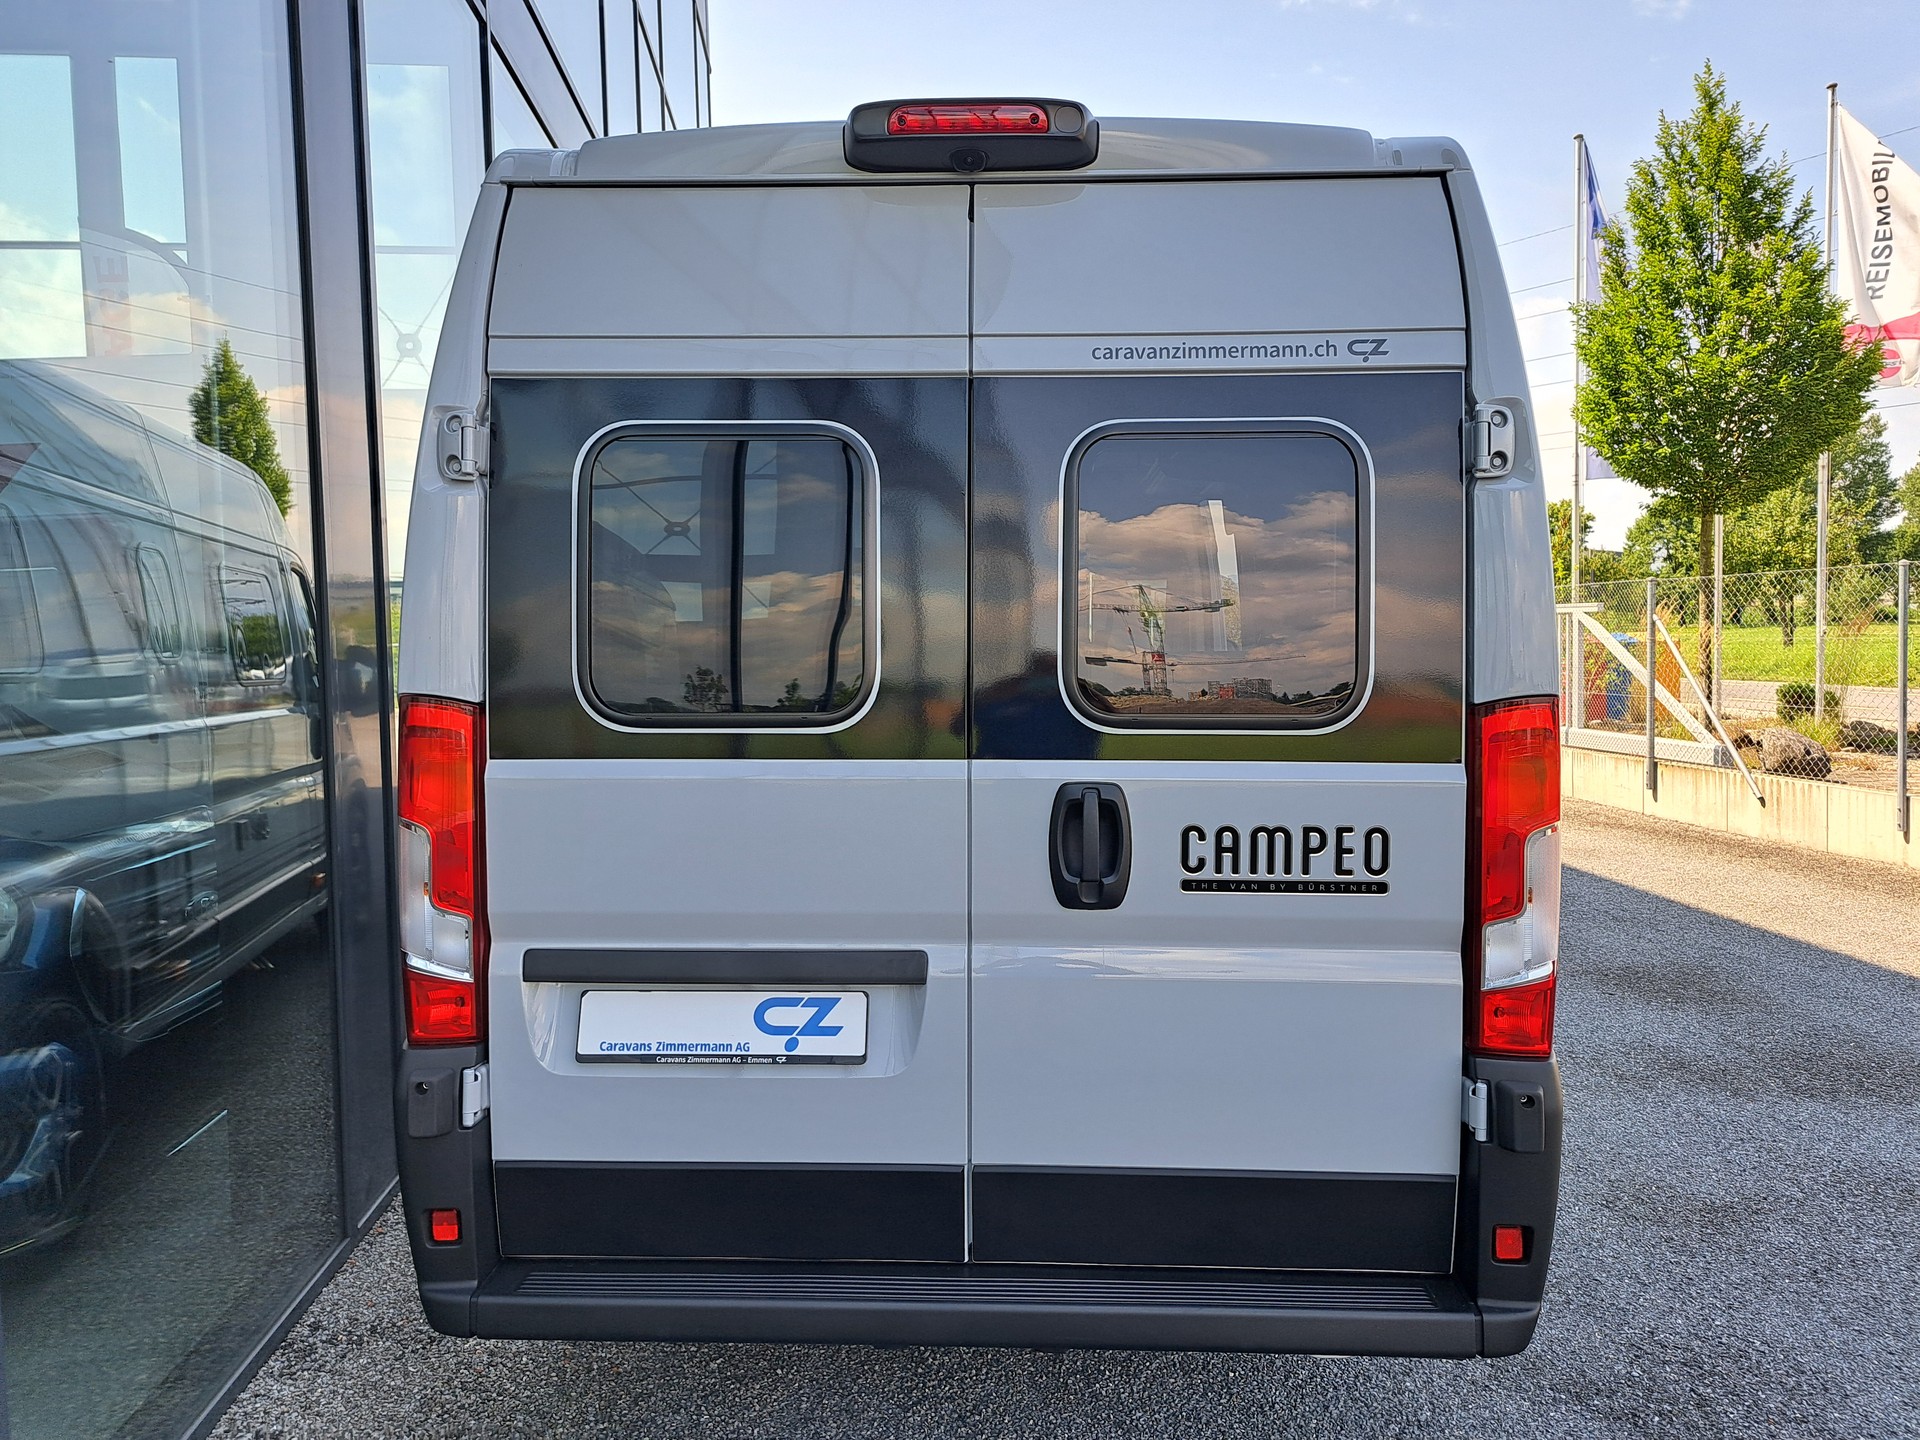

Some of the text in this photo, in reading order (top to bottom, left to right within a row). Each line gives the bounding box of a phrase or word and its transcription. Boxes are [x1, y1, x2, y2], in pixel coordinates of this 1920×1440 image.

[1091, 340, 1338, 361] caravanzimmermann.ch
[1180, 823, 1391, 877] CAMPEO
[1191, 882, 1379, 892] THE VAN BY BÜRSTNER
[599, 1041, 751, 1053] Caravans Zimmermann AG
[747, 1056, 773, 1064] Emmen
